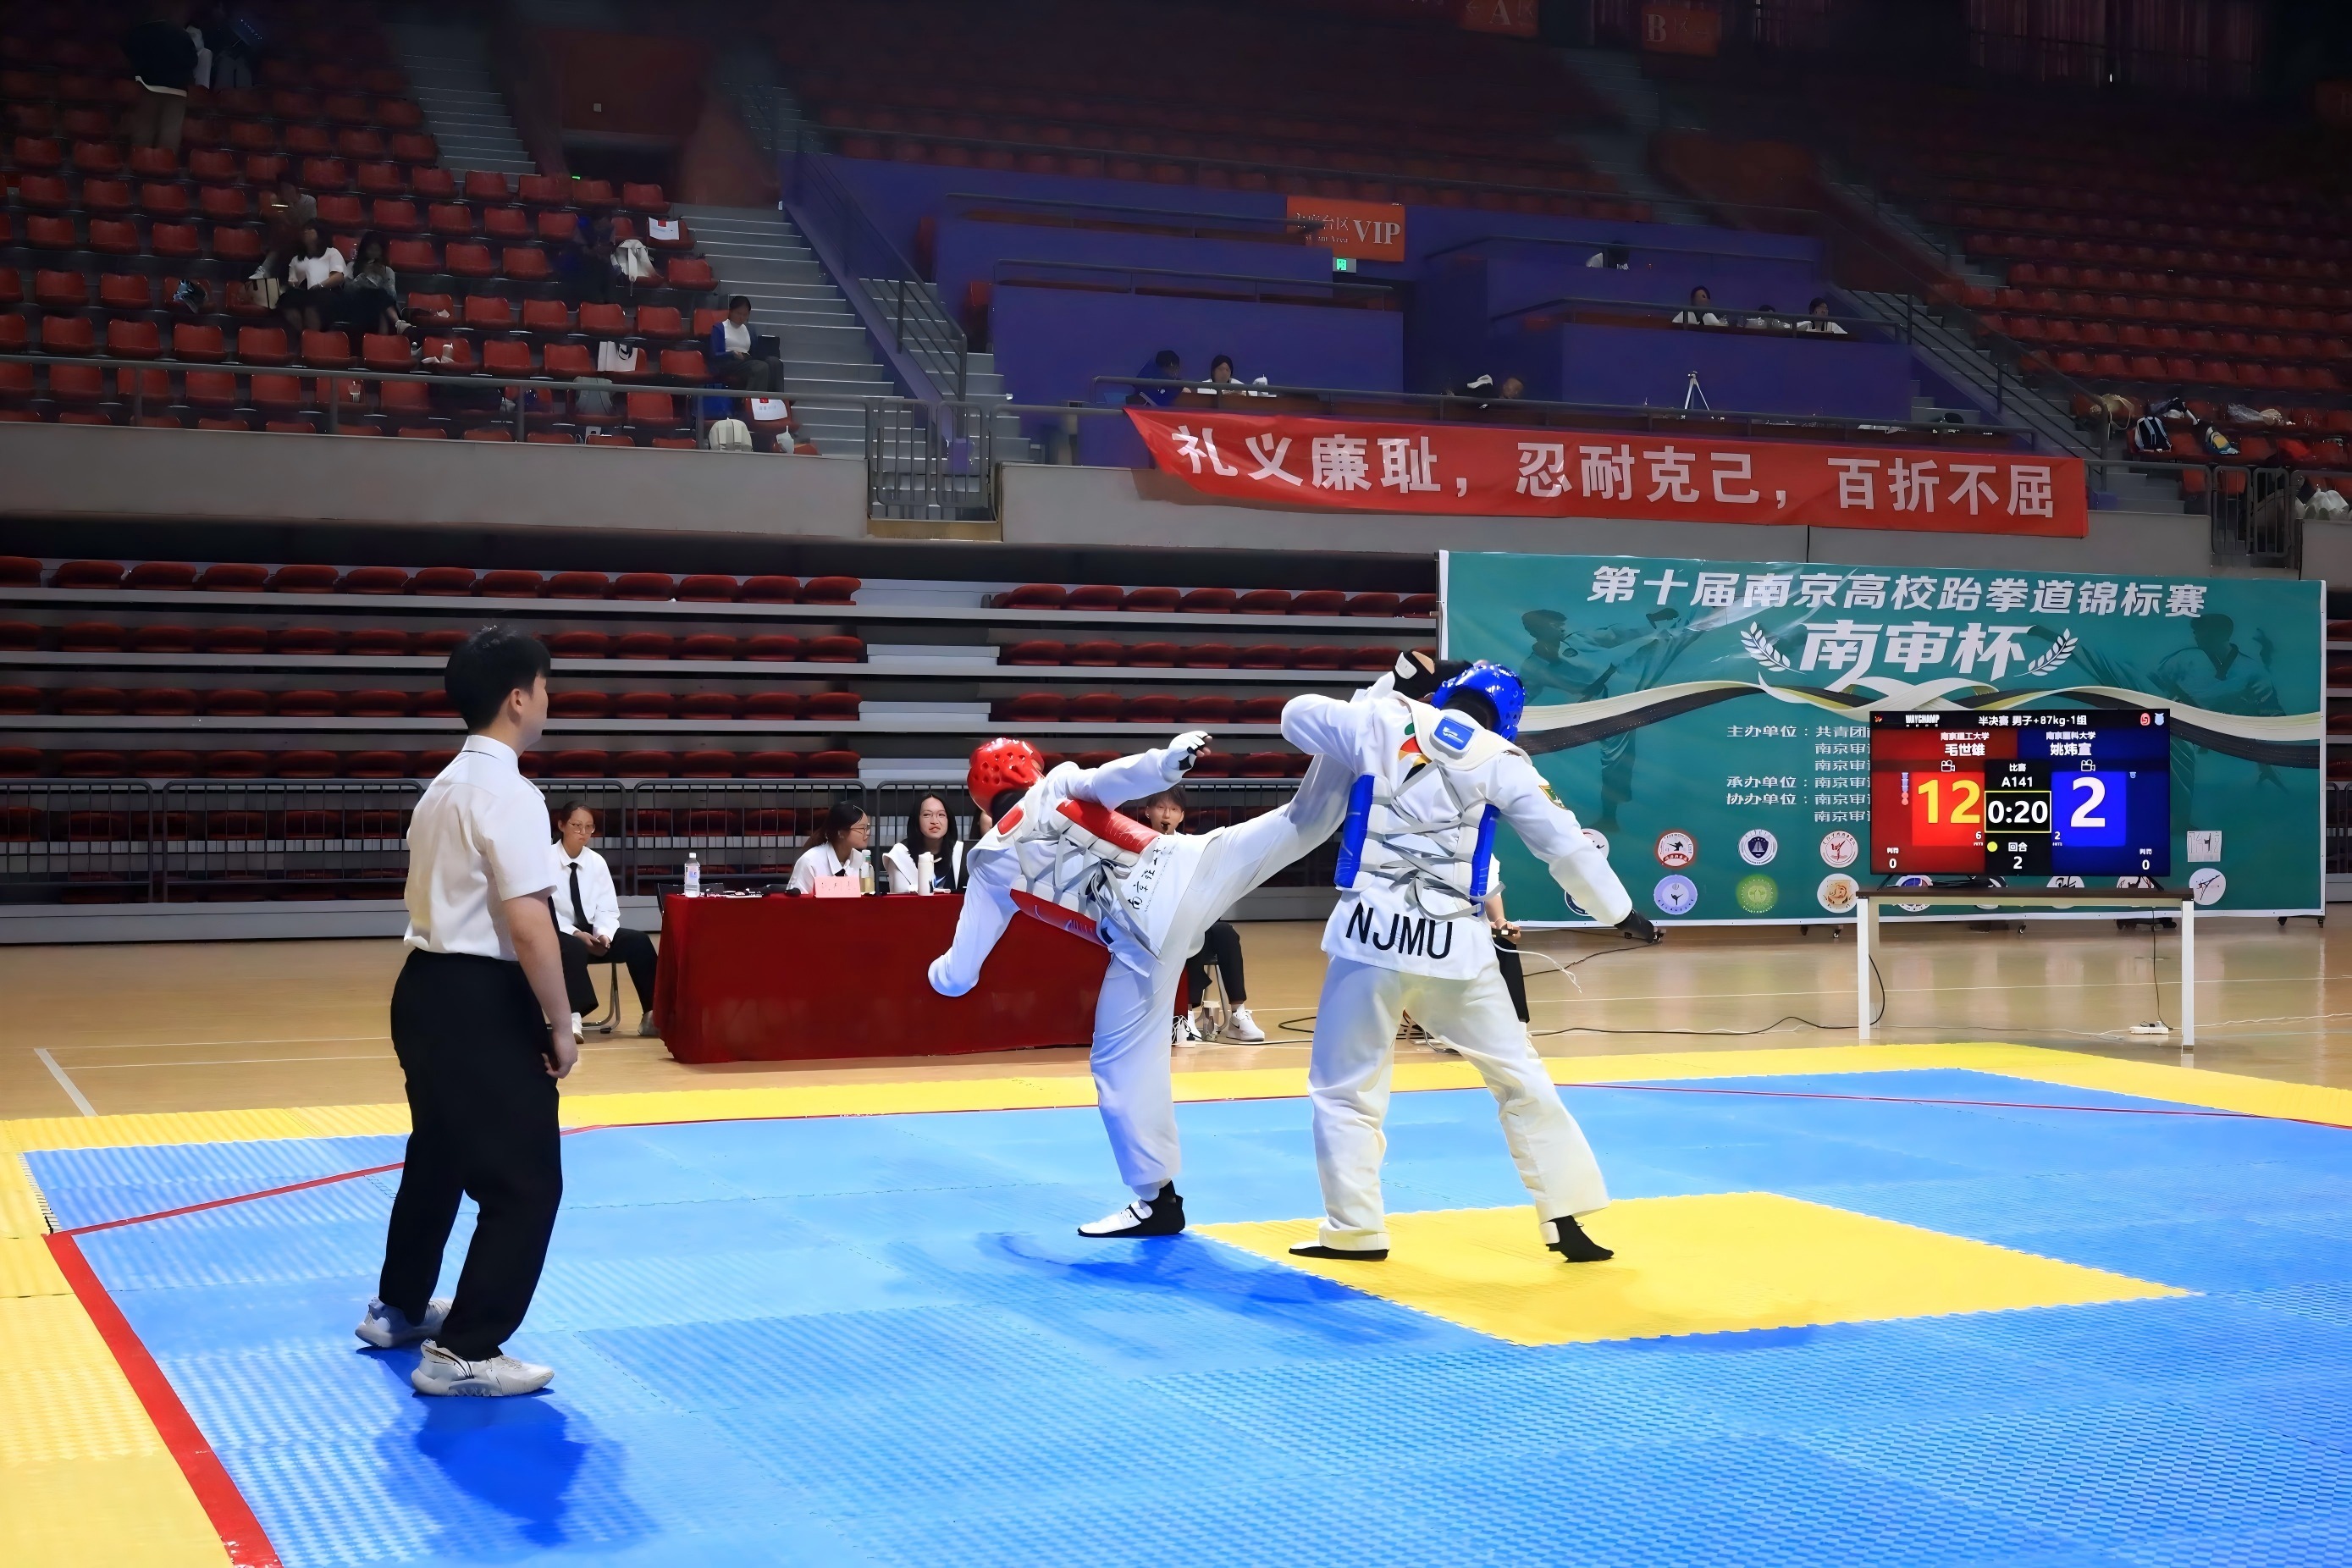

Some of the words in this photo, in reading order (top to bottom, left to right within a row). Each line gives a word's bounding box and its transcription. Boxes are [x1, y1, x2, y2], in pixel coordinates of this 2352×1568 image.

[1354, 220, 1400, 244] VIP
[1587, 566, 2207, 617] 第十届南京高校跆拳道锦标赛
[1800, 620, 2036, 693] 南审杯
[1727, 726, 1870, 737] 主办单位：共青团
[1815, 743, 1870, 754] 南京审
[1945, 743, 1985, 756] 毛世雄
[1815, 759, 1870, 771] 南京审
[1726, 776, 1870, 788] 承办单位：南京审
[2001, 776, 2033, 787] A141
[1726, 793, 1870, 805] 协办单位：南京审
[1918, 780, 1980, 824] 12
[2070, 776, 2106, 827] 2
[1814, 810, 1870, 822] 南京审
[1988, 800, 2048, 824] 0:20
[1975, 831, 1982, 840] 6
[2054, 831, 2061, 840] 2
[2008, 842, 2027, 852] 回合
[1889, 859, 1897, 869] 0
[2013, 856, 2023, 870] 2
[2142, 859, 2150, 870] 0
[1345, 902, 1453, 959] NJMU
